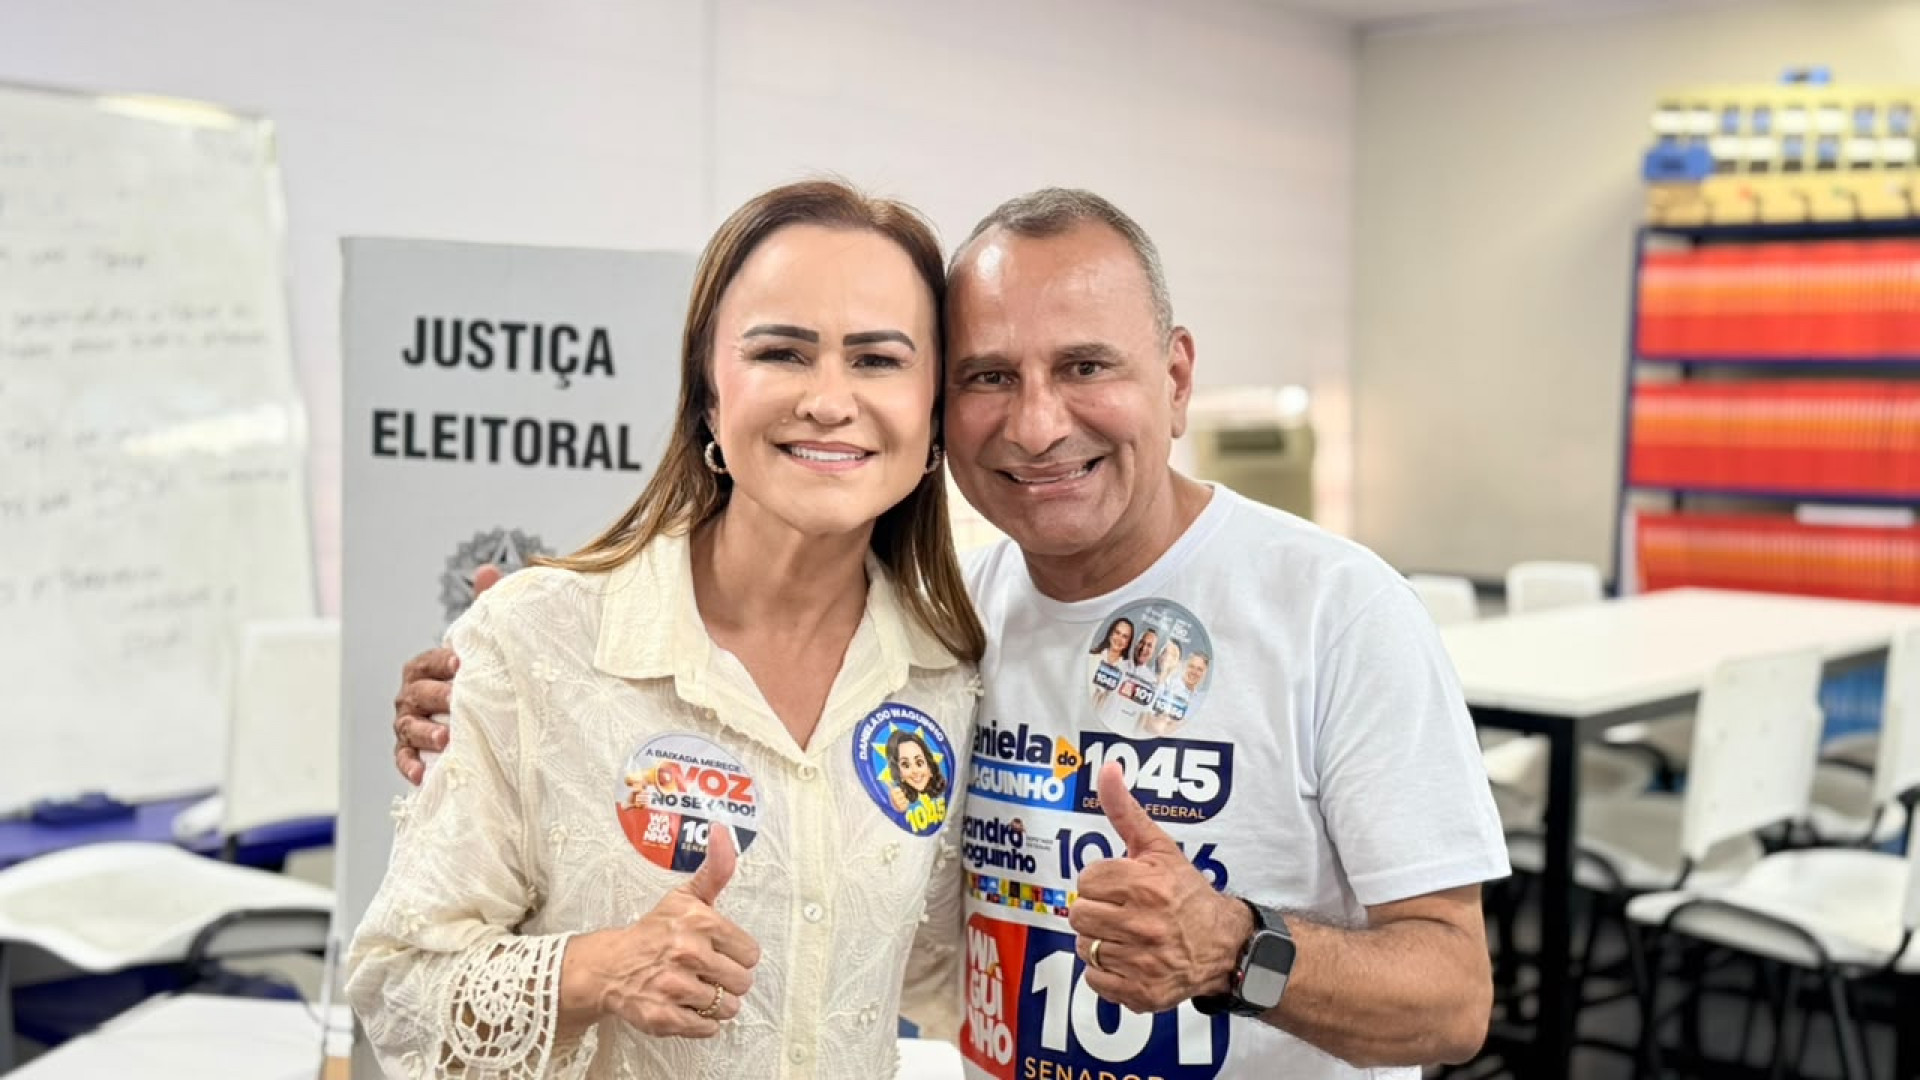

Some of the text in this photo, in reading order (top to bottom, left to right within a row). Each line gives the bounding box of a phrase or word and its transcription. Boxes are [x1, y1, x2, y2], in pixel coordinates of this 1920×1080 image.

[402, 316, 615, 390] JUSTIÇA
[371, 409, 642, 471] ELEITORAL
[655, 749, 699, 764] BAIXADA
[973, 720, 1078, 765] aniela do
[975, 764, 1065, 803] GUINHO
[1084, 741, 1221, 803] 1045
[651, 791, 678, 807] NO
[906, 792, 946, 832] 1045
[1145, 803, 1206, 820] FEDERAL
[963, 816, 1023, 848] andro
[963, 843, 1036, 874] guinho
[1055, 827, 1228, 891] 106
[968, 924, 1001, 973] WA
[969, 1004, 1013, 1065] NHO
[1024, 1056, 1165, 1080] SENA
